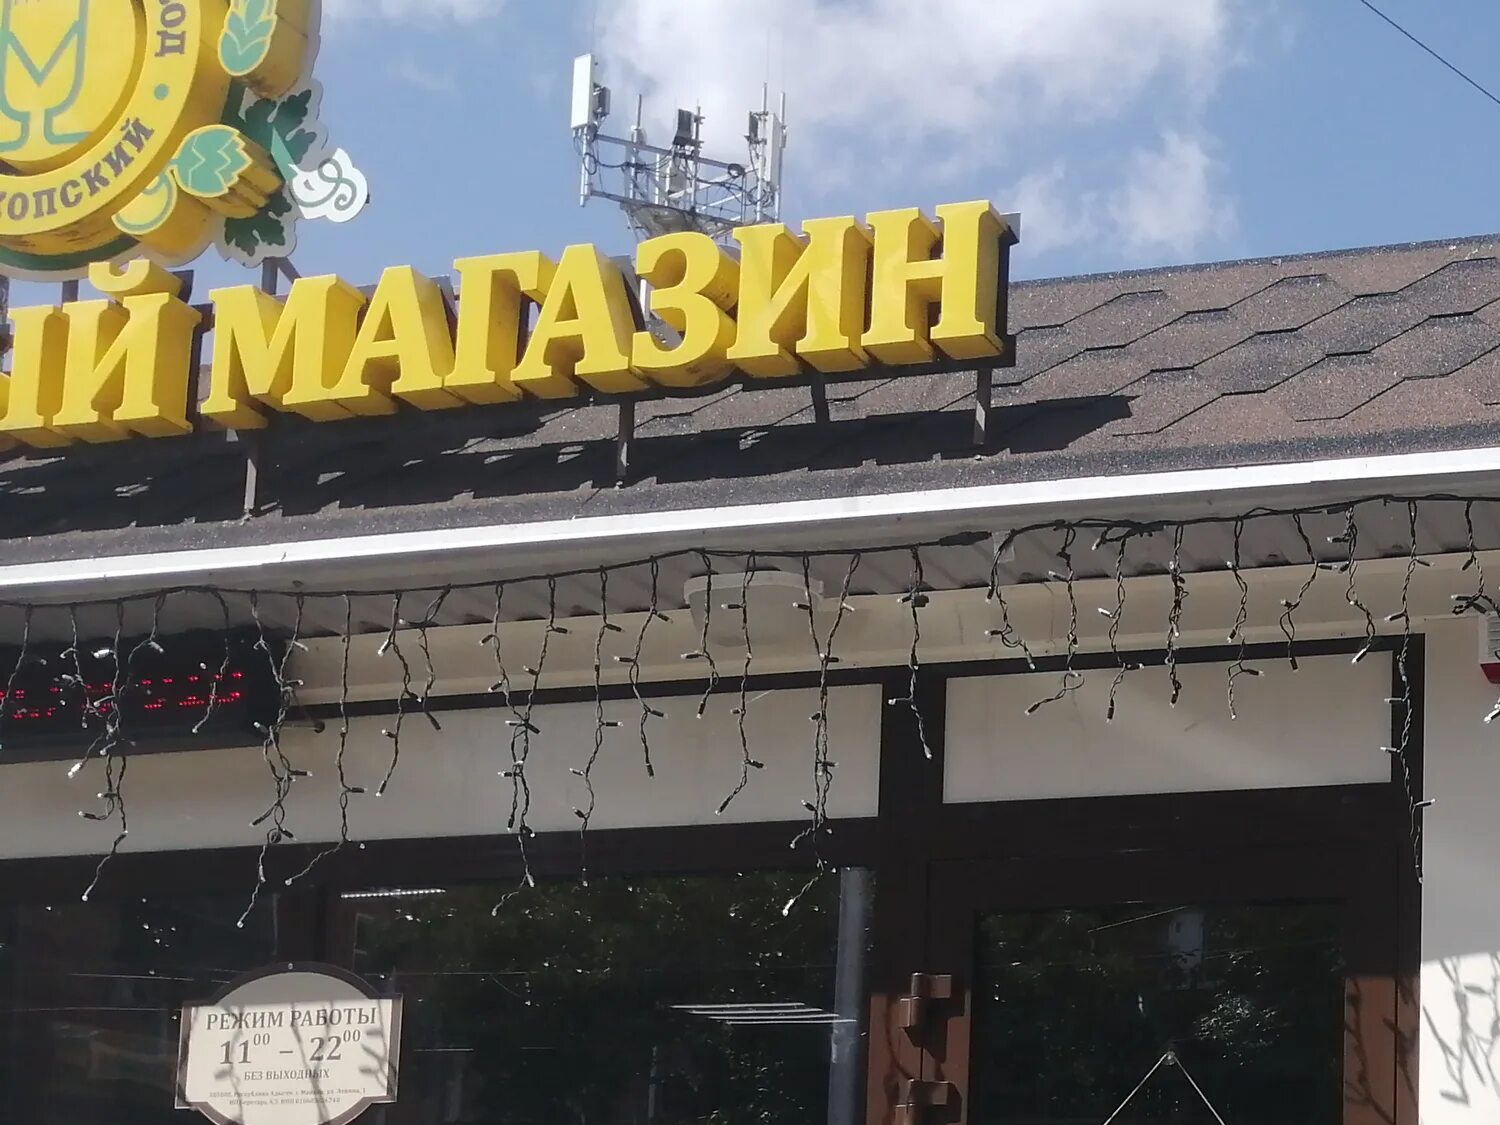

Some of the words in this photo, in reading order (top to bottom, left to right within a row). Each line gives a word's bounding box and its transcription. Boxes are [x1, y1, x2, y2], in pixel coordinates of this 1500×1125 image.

[200, 200, 1000, 416] МАГАЗИН
[207, 1011, 284, 1031] РЕЖИМ
[290, 1007, 378, 1028] РАБОТЫ
[244, 1070, 263, 1081] БЕЗ
[265, 1068, 330, 1081] ВЫХОДНЫХ
